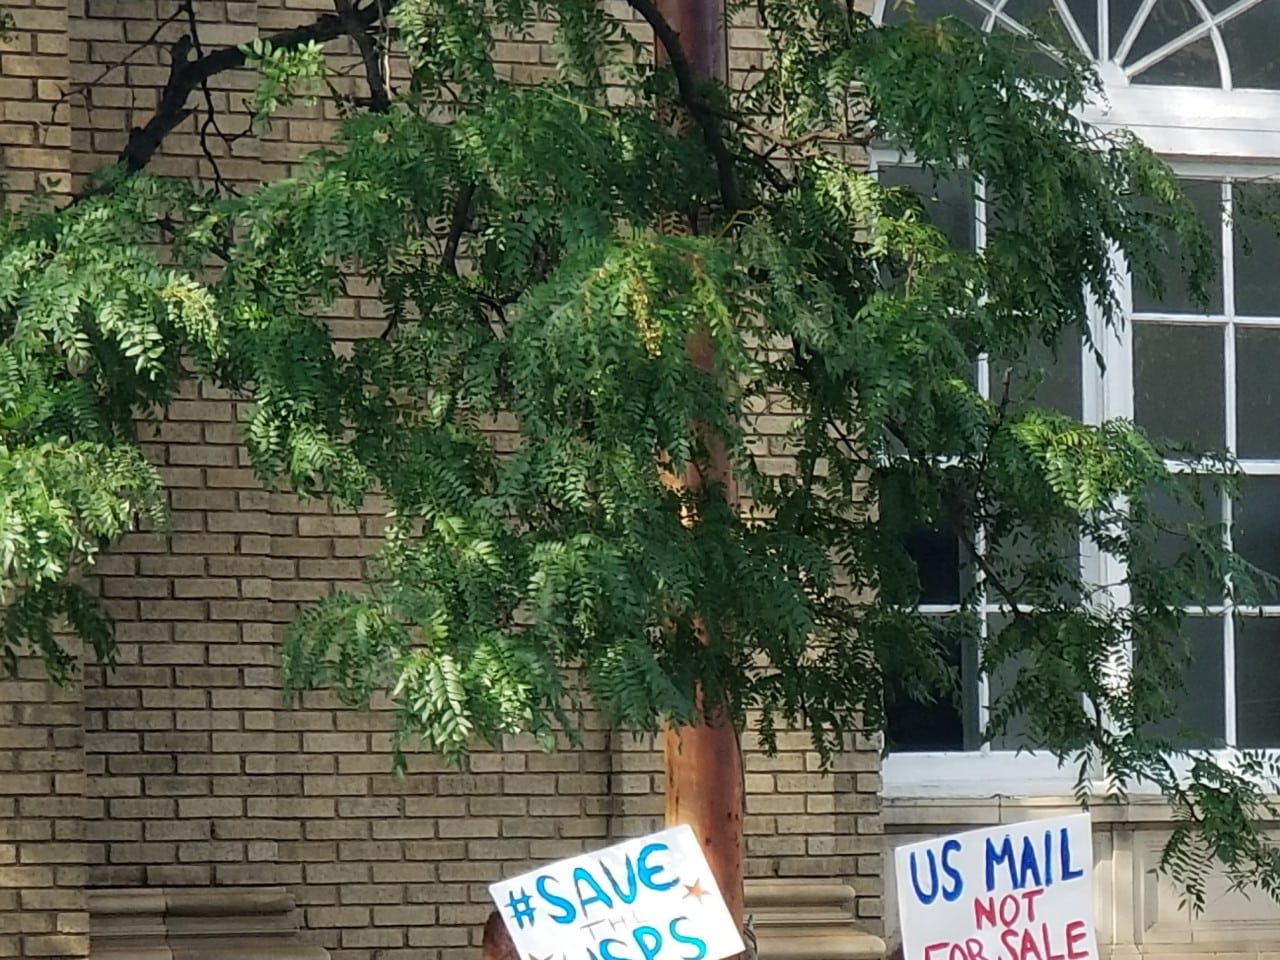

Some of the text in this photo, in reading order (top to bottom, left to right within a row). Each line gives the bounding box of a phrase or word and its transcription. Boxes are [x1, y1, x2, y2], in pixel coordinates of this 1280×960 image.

[504, 843, 680, 929] #SAVE
[910, 827, 1083, 905] US MAIL
[974, 888, 1044, 930] NOT
